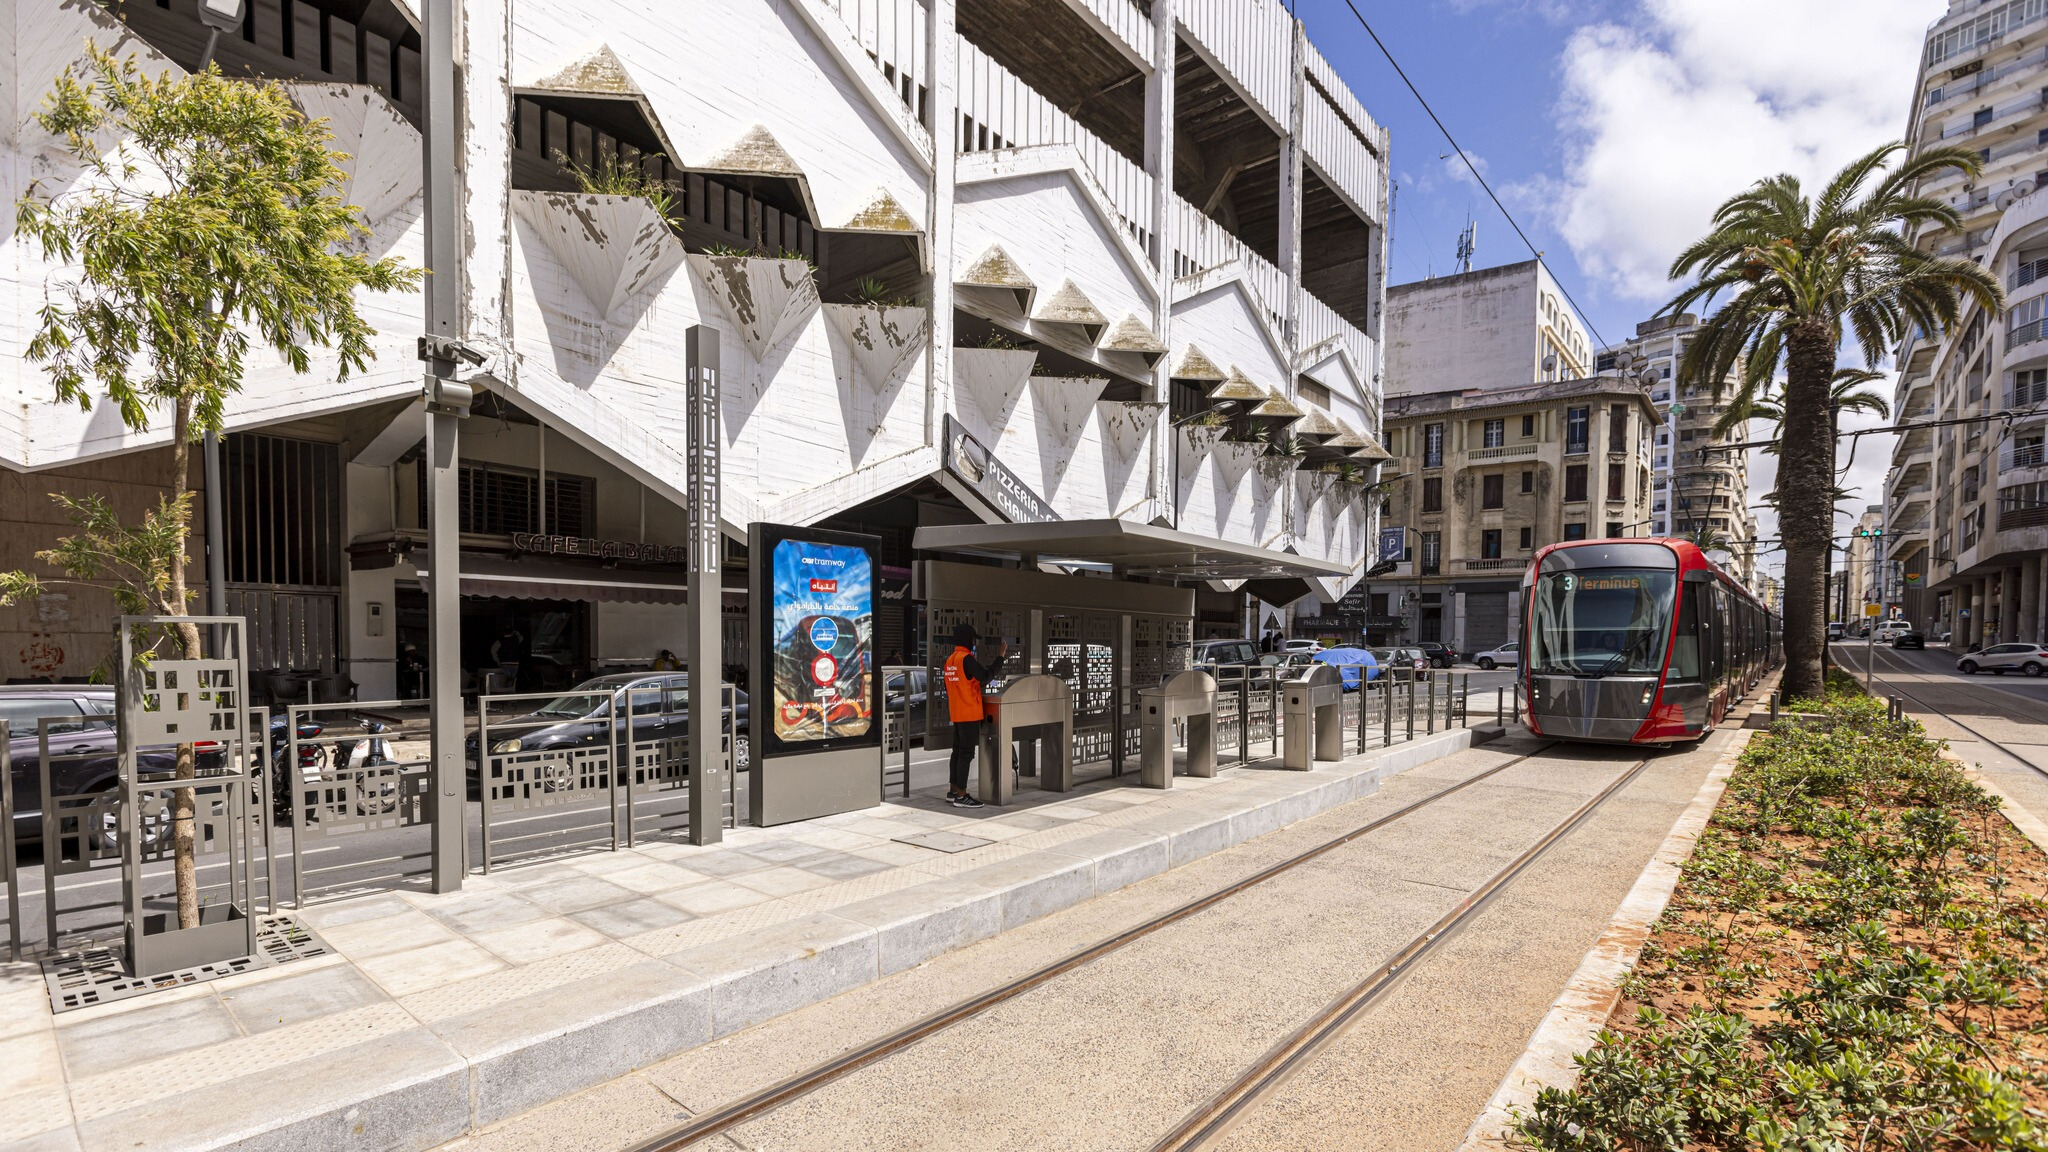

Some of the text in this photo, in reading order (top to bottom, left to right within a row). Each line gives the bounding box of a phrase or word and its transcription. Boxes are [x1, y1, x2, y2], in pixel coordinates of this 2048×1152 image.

[989, 461, 1039, 516] PIZZERIA
[513, 531, 579, 554] CAFE
[588, 538, 615, 558] LA
[1388, 538, 1396, 549] P
[1564, 575, 1639, 590] 3 Terminus
